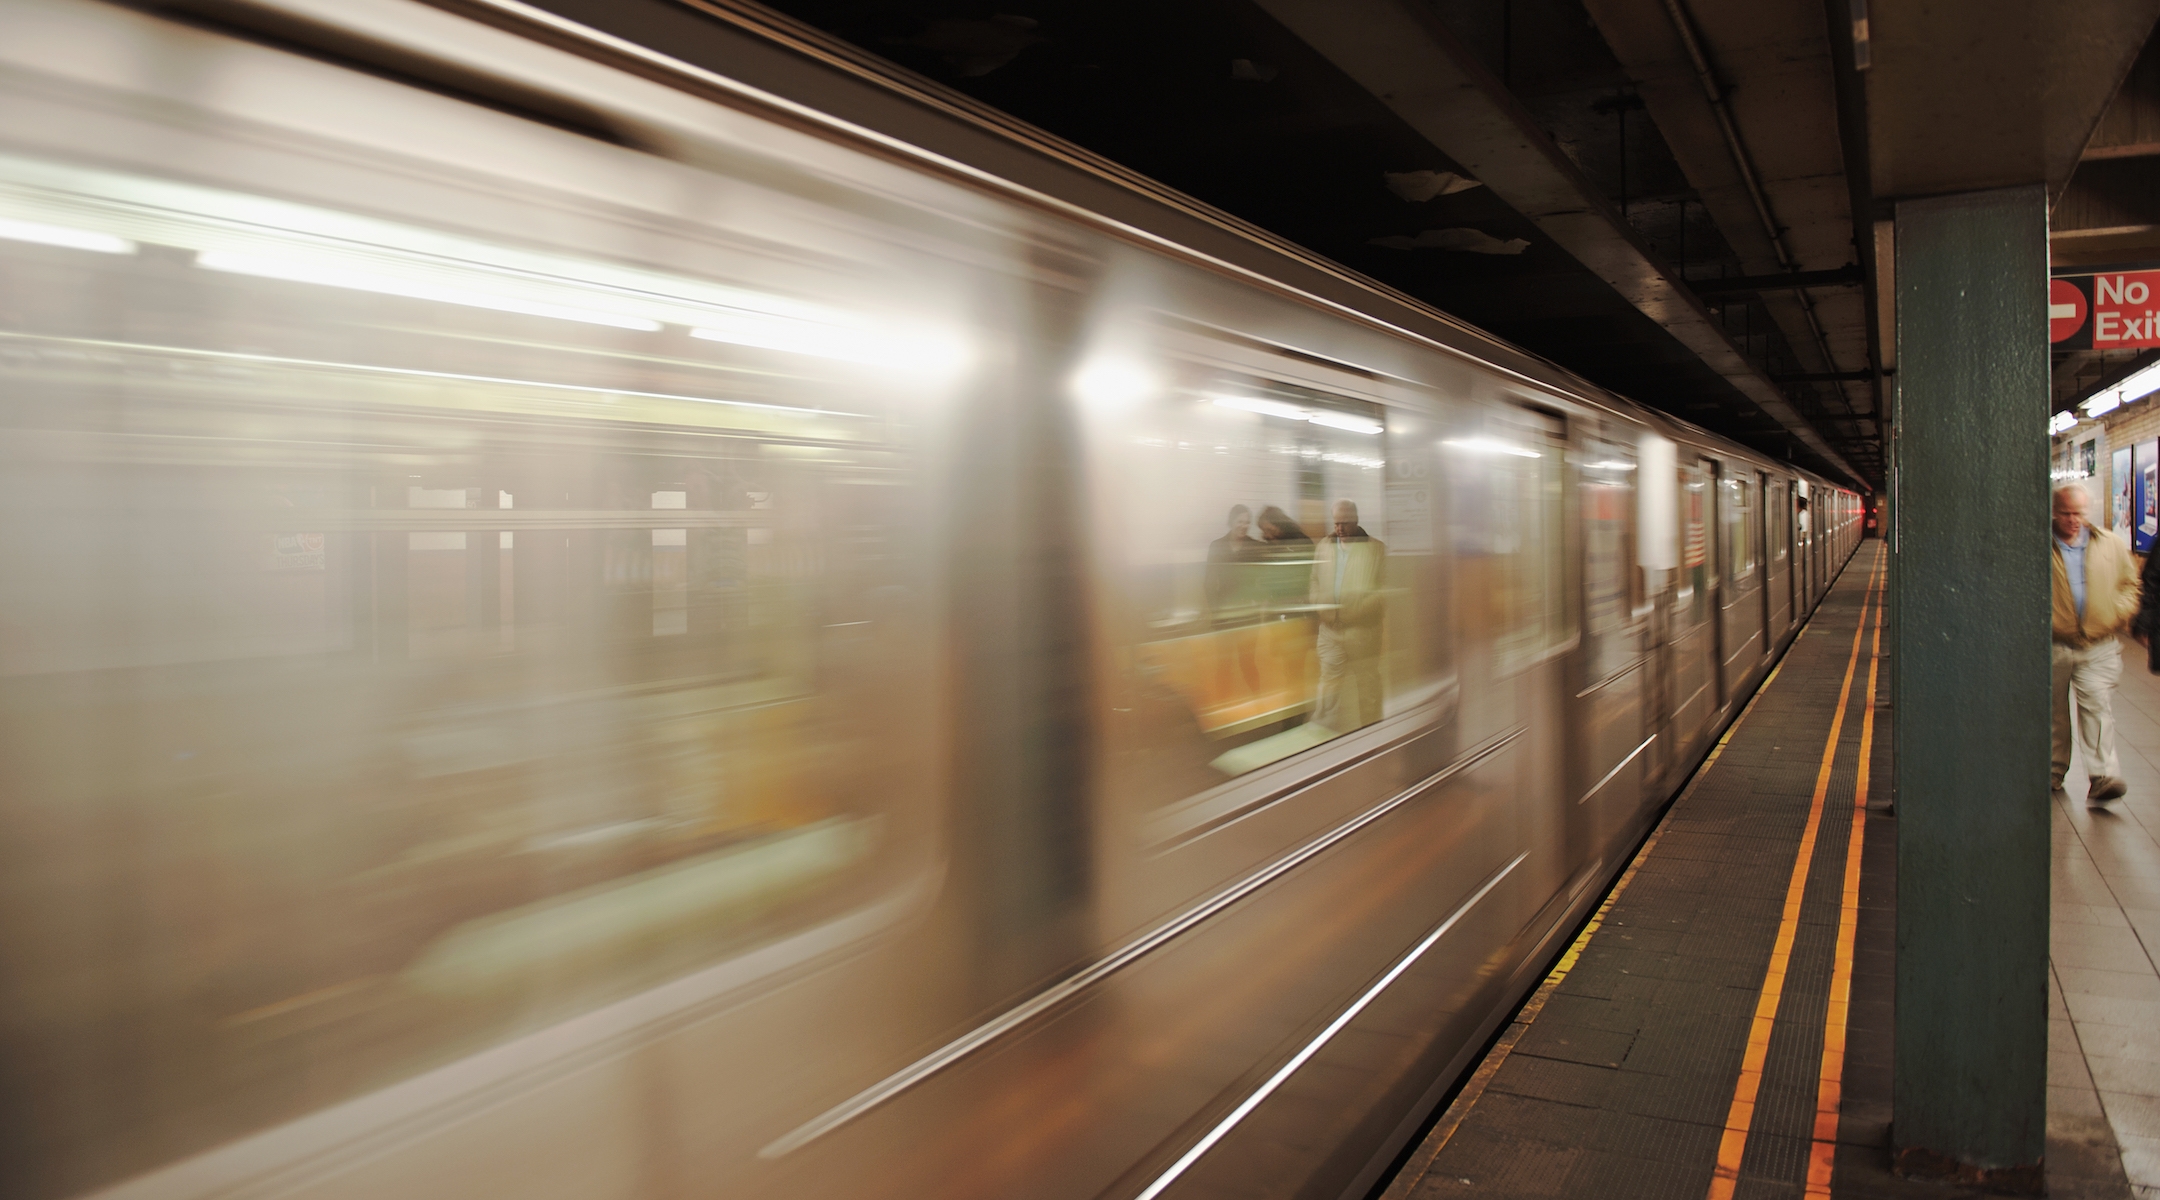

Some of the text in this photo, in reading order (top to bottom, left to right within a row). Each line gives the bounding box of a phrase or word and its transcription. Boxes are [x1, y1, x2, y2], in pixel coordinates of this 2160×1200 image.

[2096, 275, 2150, 306] No
[278, 536, 323, 549] NBA TNT
[276, 553, 326, 569] THURSDAYS
